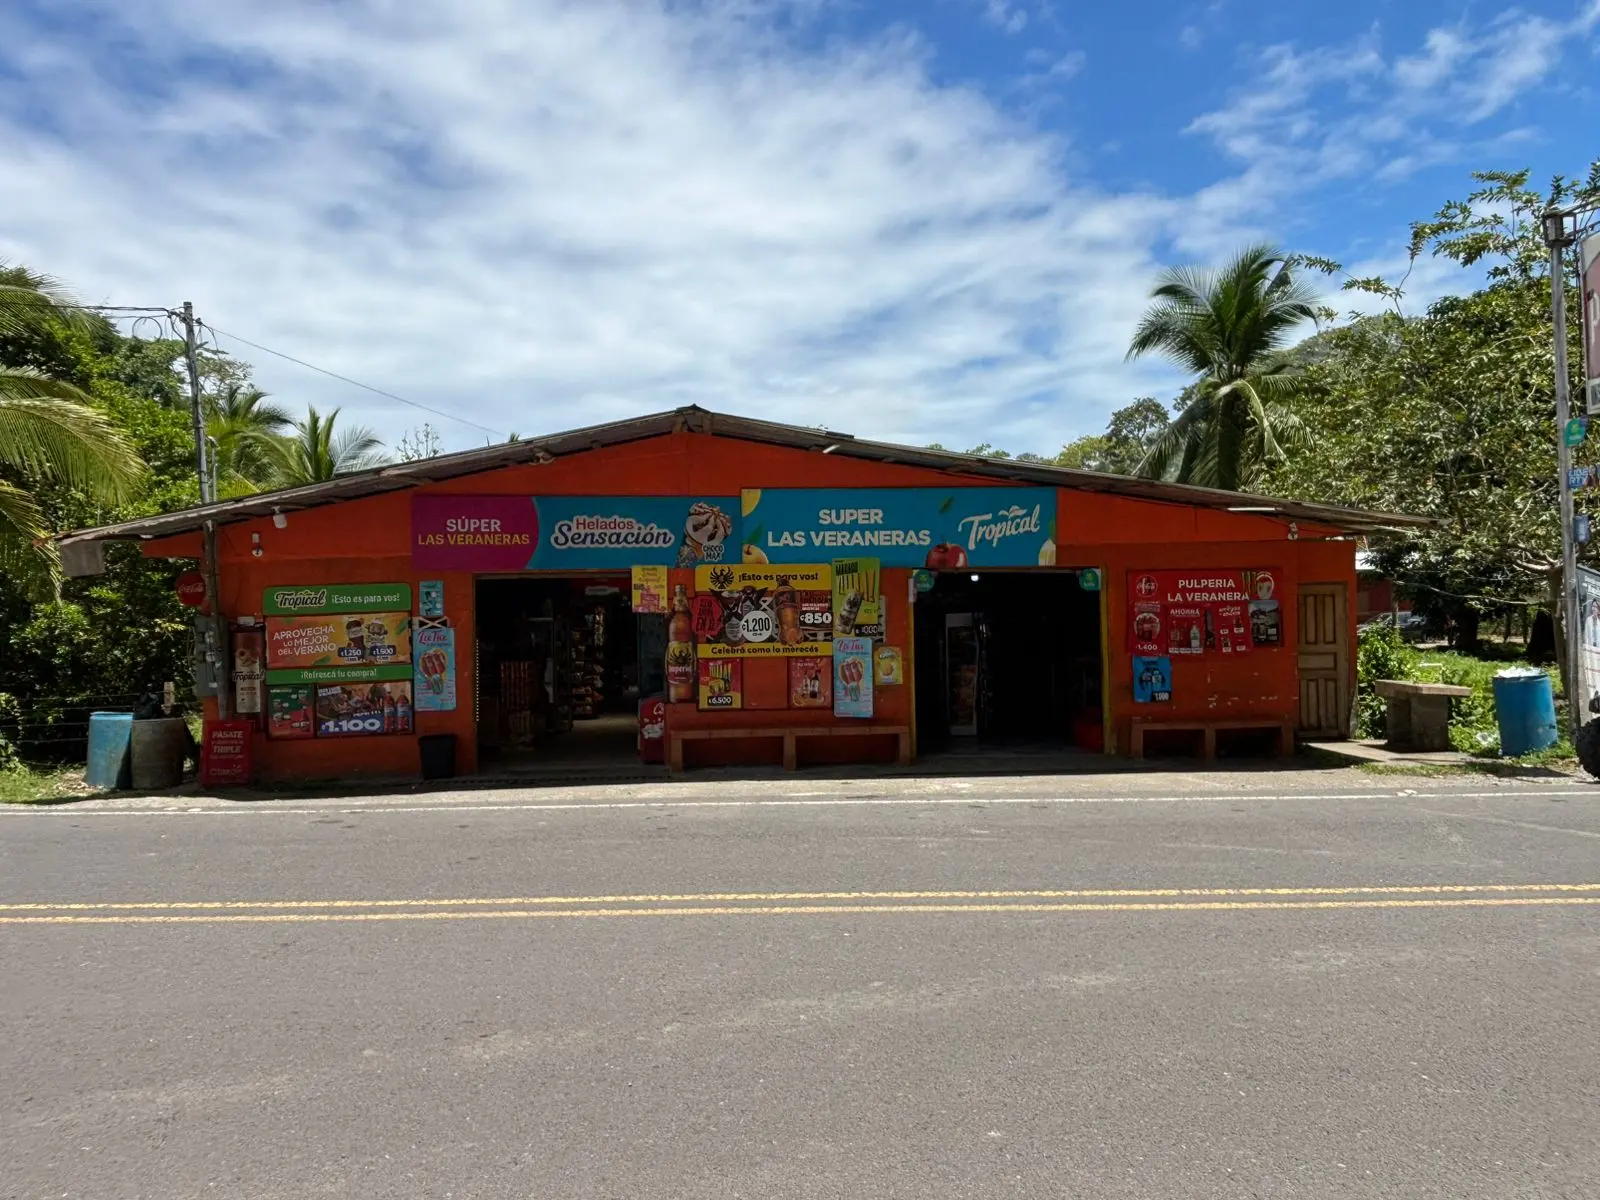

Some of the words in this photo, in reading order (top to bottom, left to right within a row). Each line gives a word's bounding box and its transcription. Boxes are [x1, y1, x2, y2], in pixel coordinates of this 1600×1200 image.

[819, 508, 884, 525] SUPER
[446, 516, 501, 532] SÚPER
[576, 518, 634, 530] Helados
[958, 504, 1040, 550] Tropical
[418, 534, 444, 545] LAS
[447, 534, 530, 545] VERANERAS
[553, 523, 672, 547] Sensación
[767, 530, 806, 547] LAS
[808, 529, 931, 546] VERANERAS
[739, 573, 761, 583] ¡Esto
[776, 574, 797, 583] para
[1178, 578, 1235, 589] PULPERIA
[275, 589, 327, 610] Tropical
[332, 594, 352, 604] ¡Esto
[364, 595, 382, 604] para
[383, 592, 400, 602] vos!
[1167, 593, 1183, 602] LA
[1186, 591, 1250, 601] VERANERA
[273, 624, 336, 641] APROVECHÁ
[294, 635, 329, 647] MEJOR
[277, 648, 293, 656] DEL
[293, 643, 337, 656] VERANO
[711, 646, 745, 654] Celebrá
[337, 669, 345, 677] tu
[347, 668, 377, 679] compra!
